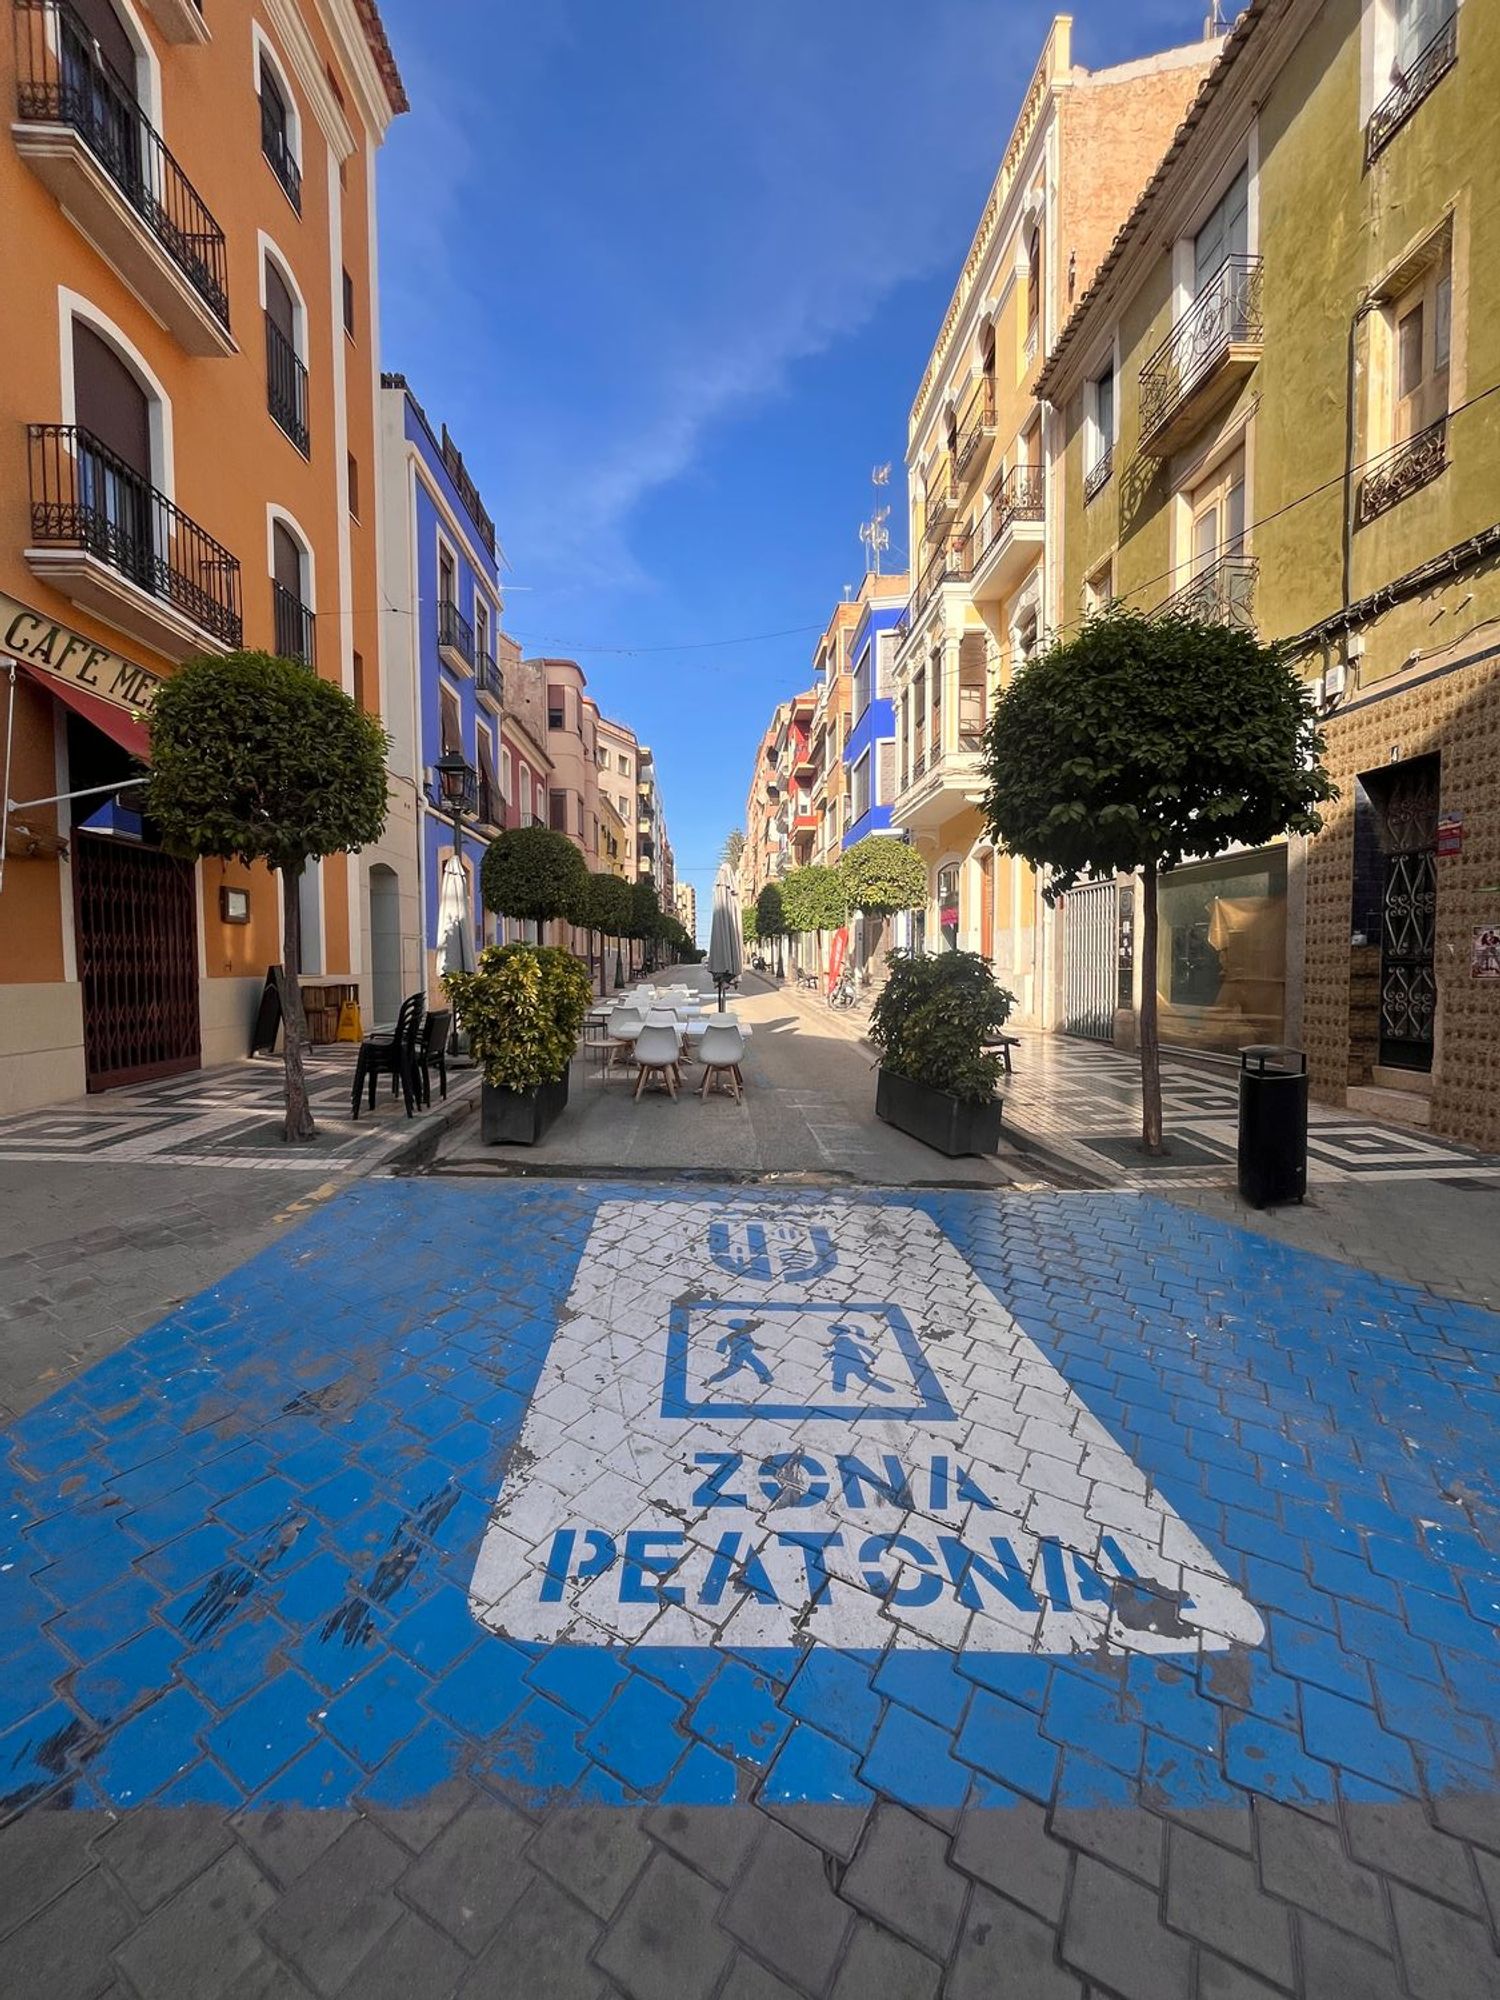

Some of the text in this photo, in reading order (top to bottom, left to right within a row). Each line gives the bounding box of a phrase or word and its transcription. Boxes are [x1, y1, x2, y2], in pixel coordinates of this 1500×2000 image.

[4, 612, 158, 711] CAFE ME
[692, 1451, 996, 1511] ZONA
